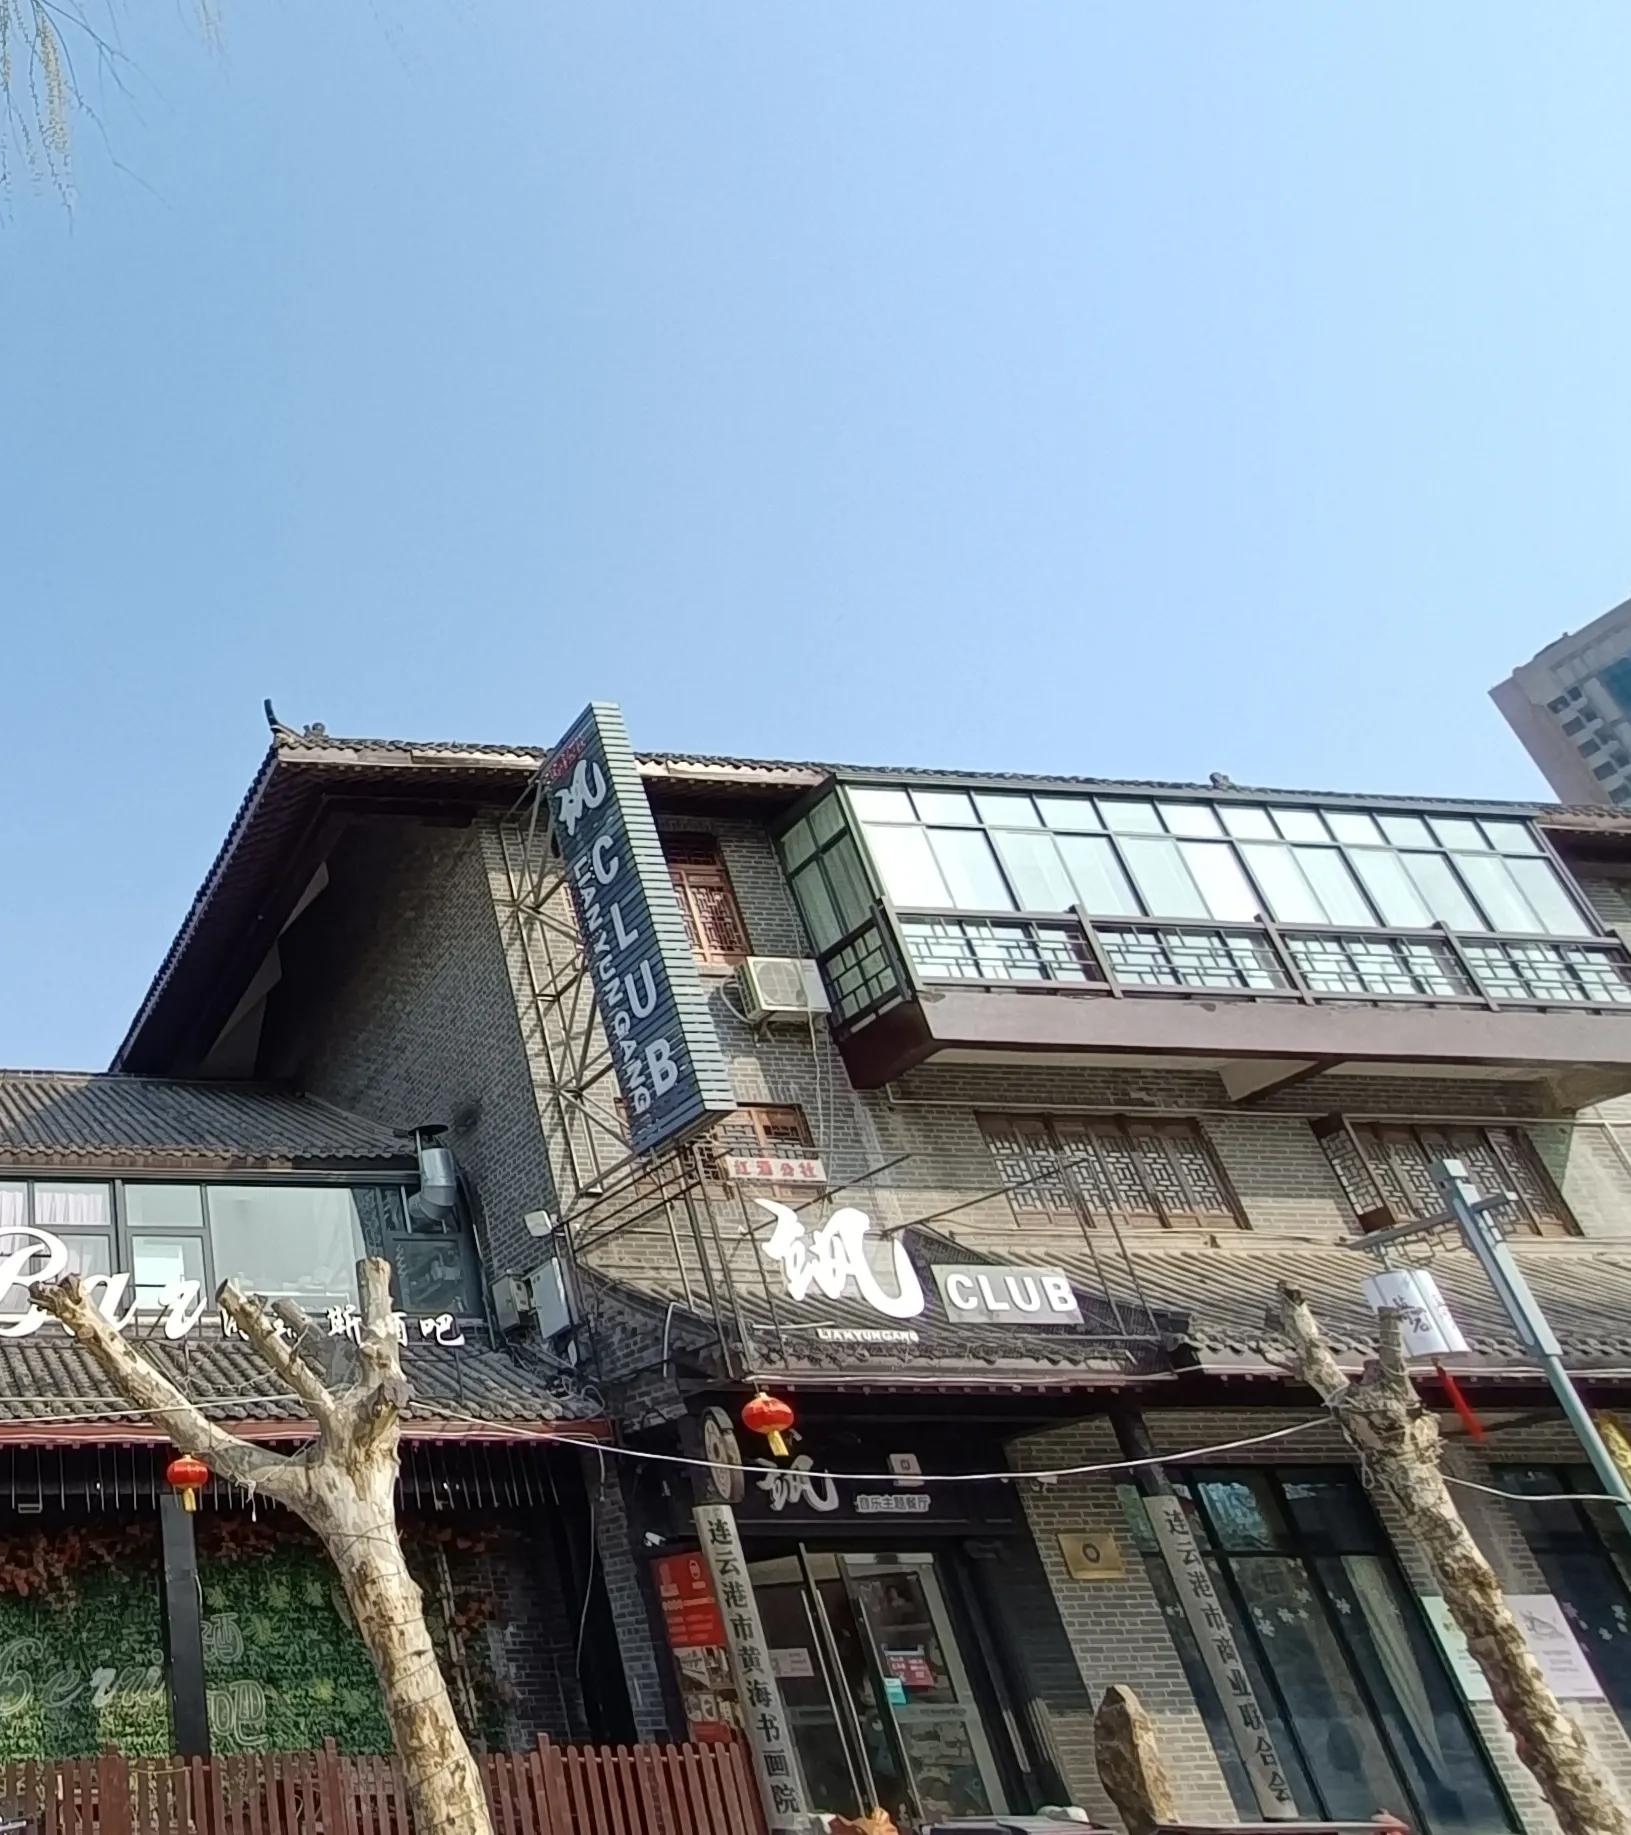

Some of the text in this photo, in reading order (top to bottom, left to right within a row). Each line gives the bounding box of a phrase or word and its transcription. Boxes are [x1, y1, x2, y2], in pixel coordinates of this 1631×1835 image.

[572, 855, 653, 1116] LIANYUNGANG
[590, 834, 679, 1098] CLUB
[945, 1273, 1079, 1312] CLUB
[856, 1494, 932, 1513] 音乐主题餐厅
[707, 1518, 800, 1815] 连云港市黄海书画院
